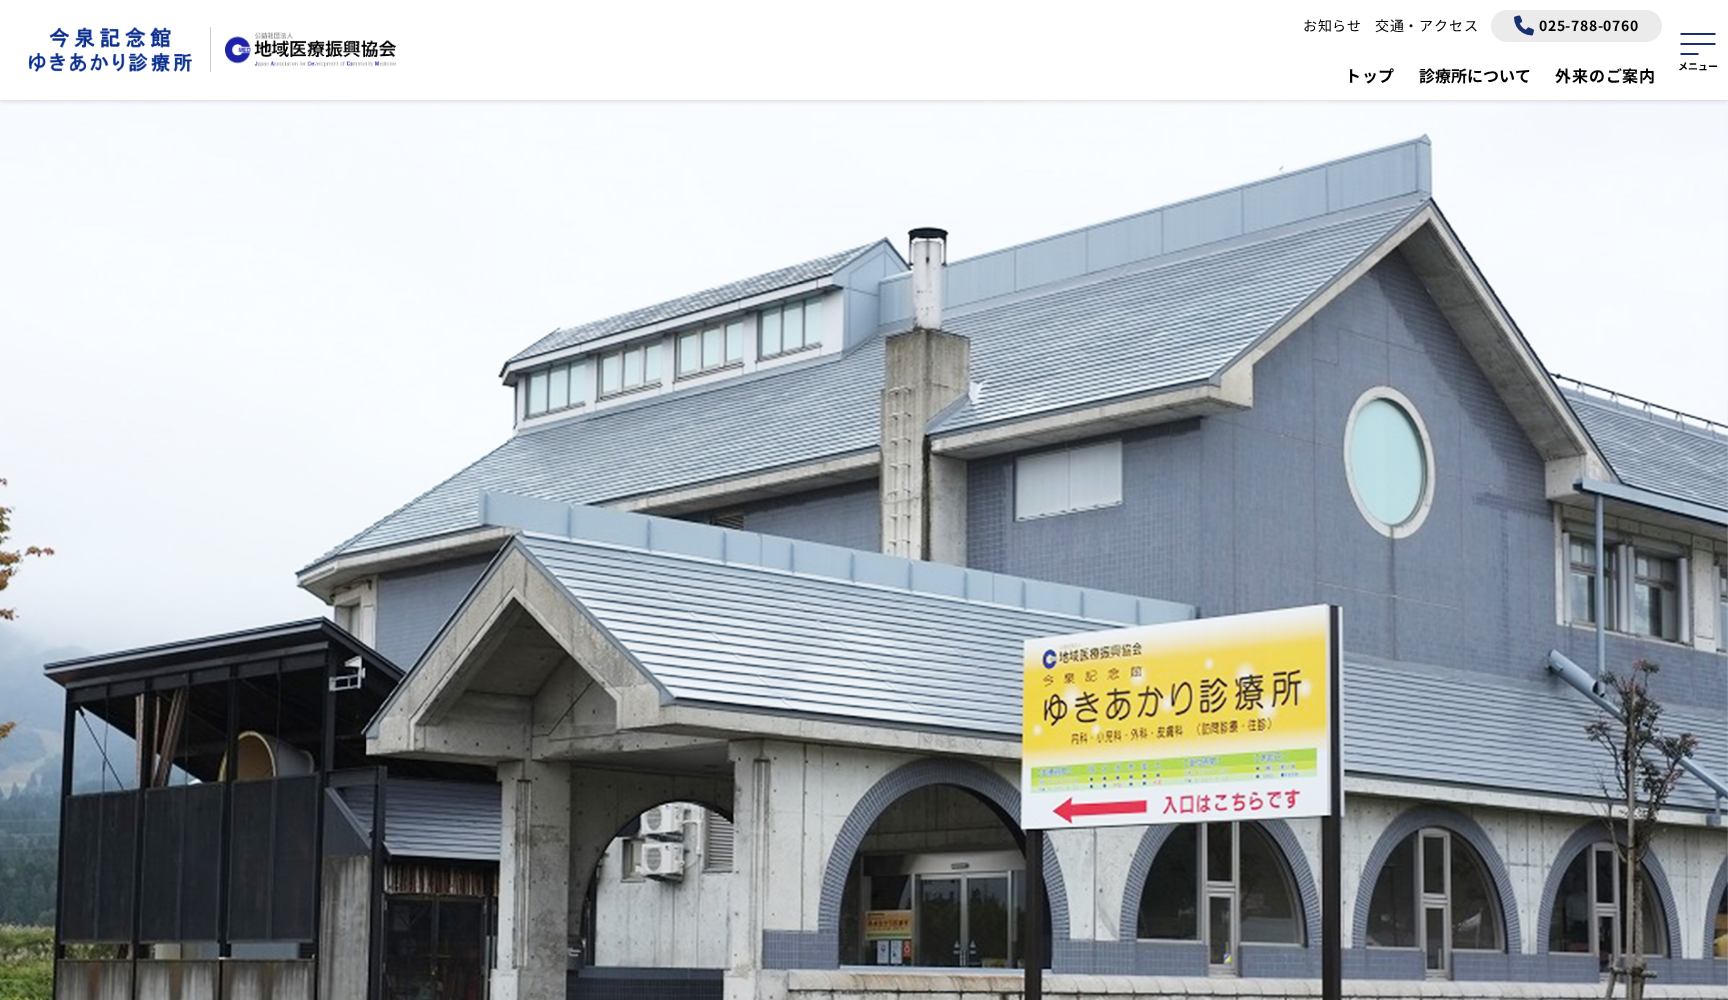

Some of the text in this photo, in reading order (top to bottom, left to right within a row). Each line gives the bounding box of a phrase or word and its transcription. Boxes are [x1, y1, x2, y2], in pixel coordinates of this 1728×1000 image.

[1043, 669, 1303, 726] ゆきあかり診療所
[1162, 789, 1301, 815] 入口はこちらです
